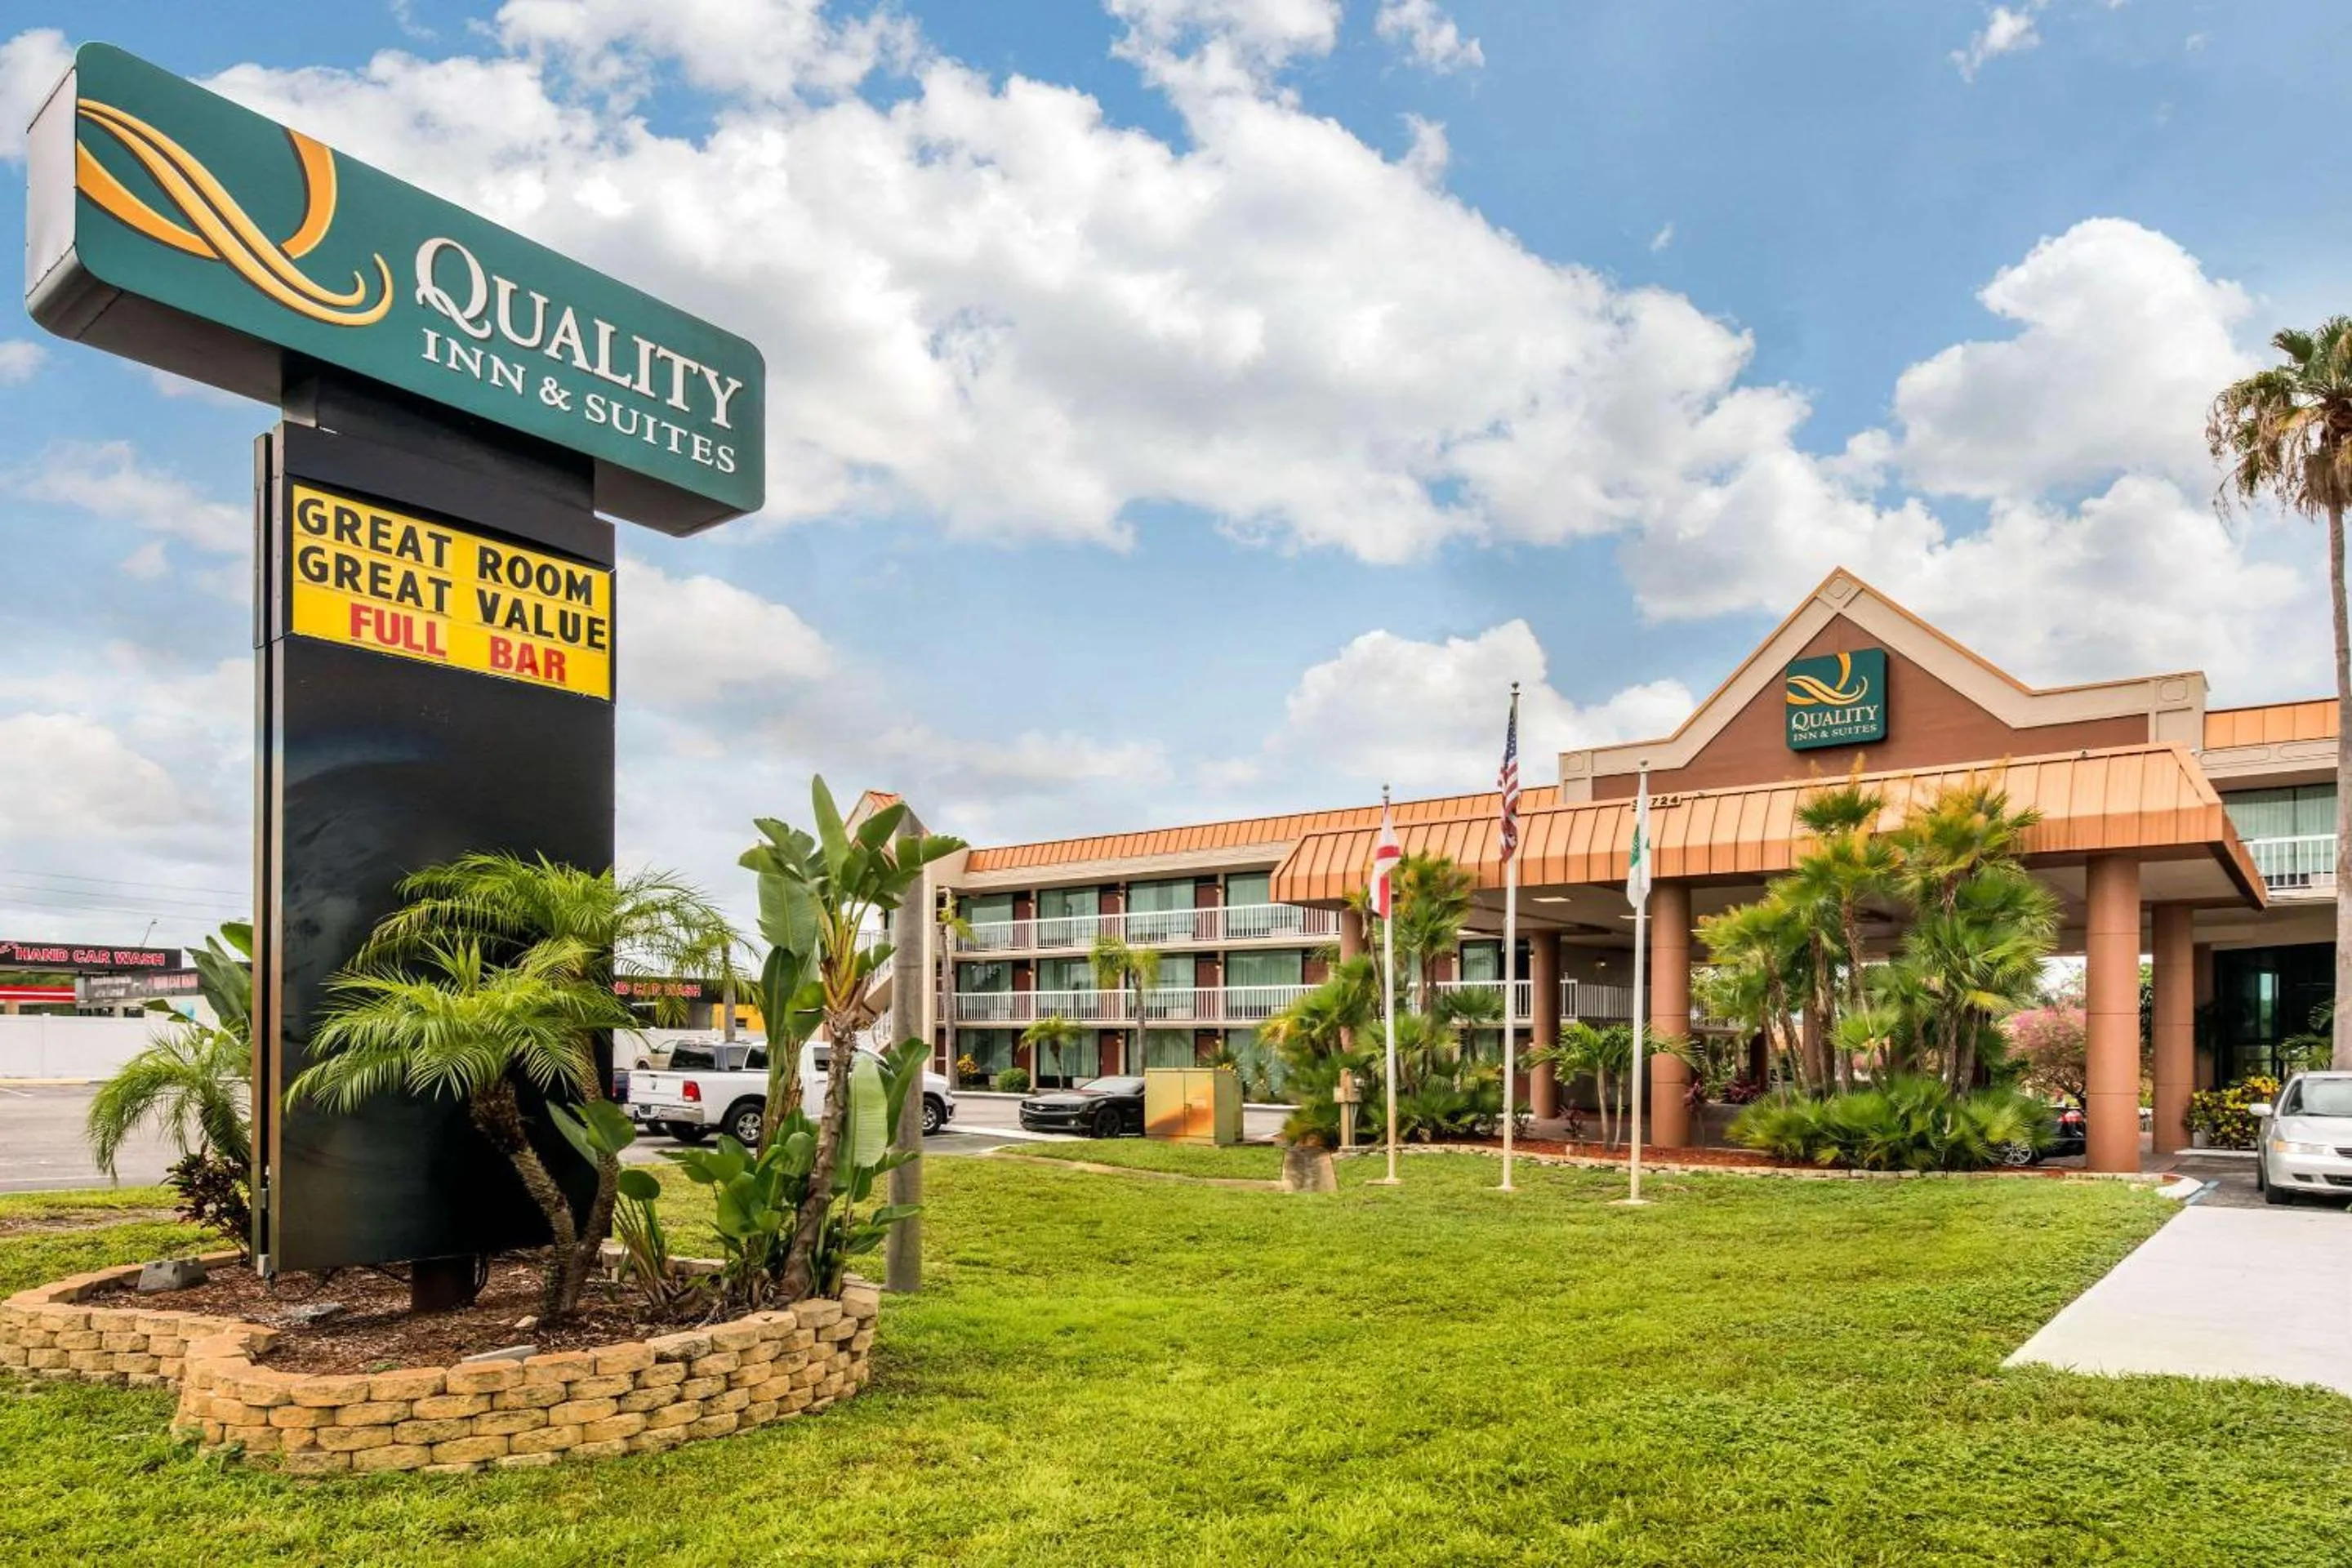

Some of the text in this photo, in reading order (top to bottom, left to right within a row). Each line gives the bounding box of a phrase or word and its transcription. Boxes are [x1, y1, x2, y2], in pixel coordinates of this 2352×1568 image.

[415, 237, 742, 430] QUALITY
[421, 327, 736, 474] INN & SUITES
[297, 497, 593, 606] GREAT ROOM
[298, 545, 606, 650] GREAT VALUE
[350, 602, 566, 683] FULL BAR
[1792, 705, 1878, 732] QUALITY
[1793, 724, 1878, 742] INN & SUITES
[16, 947, 166, 967] HAND CAR WASH
